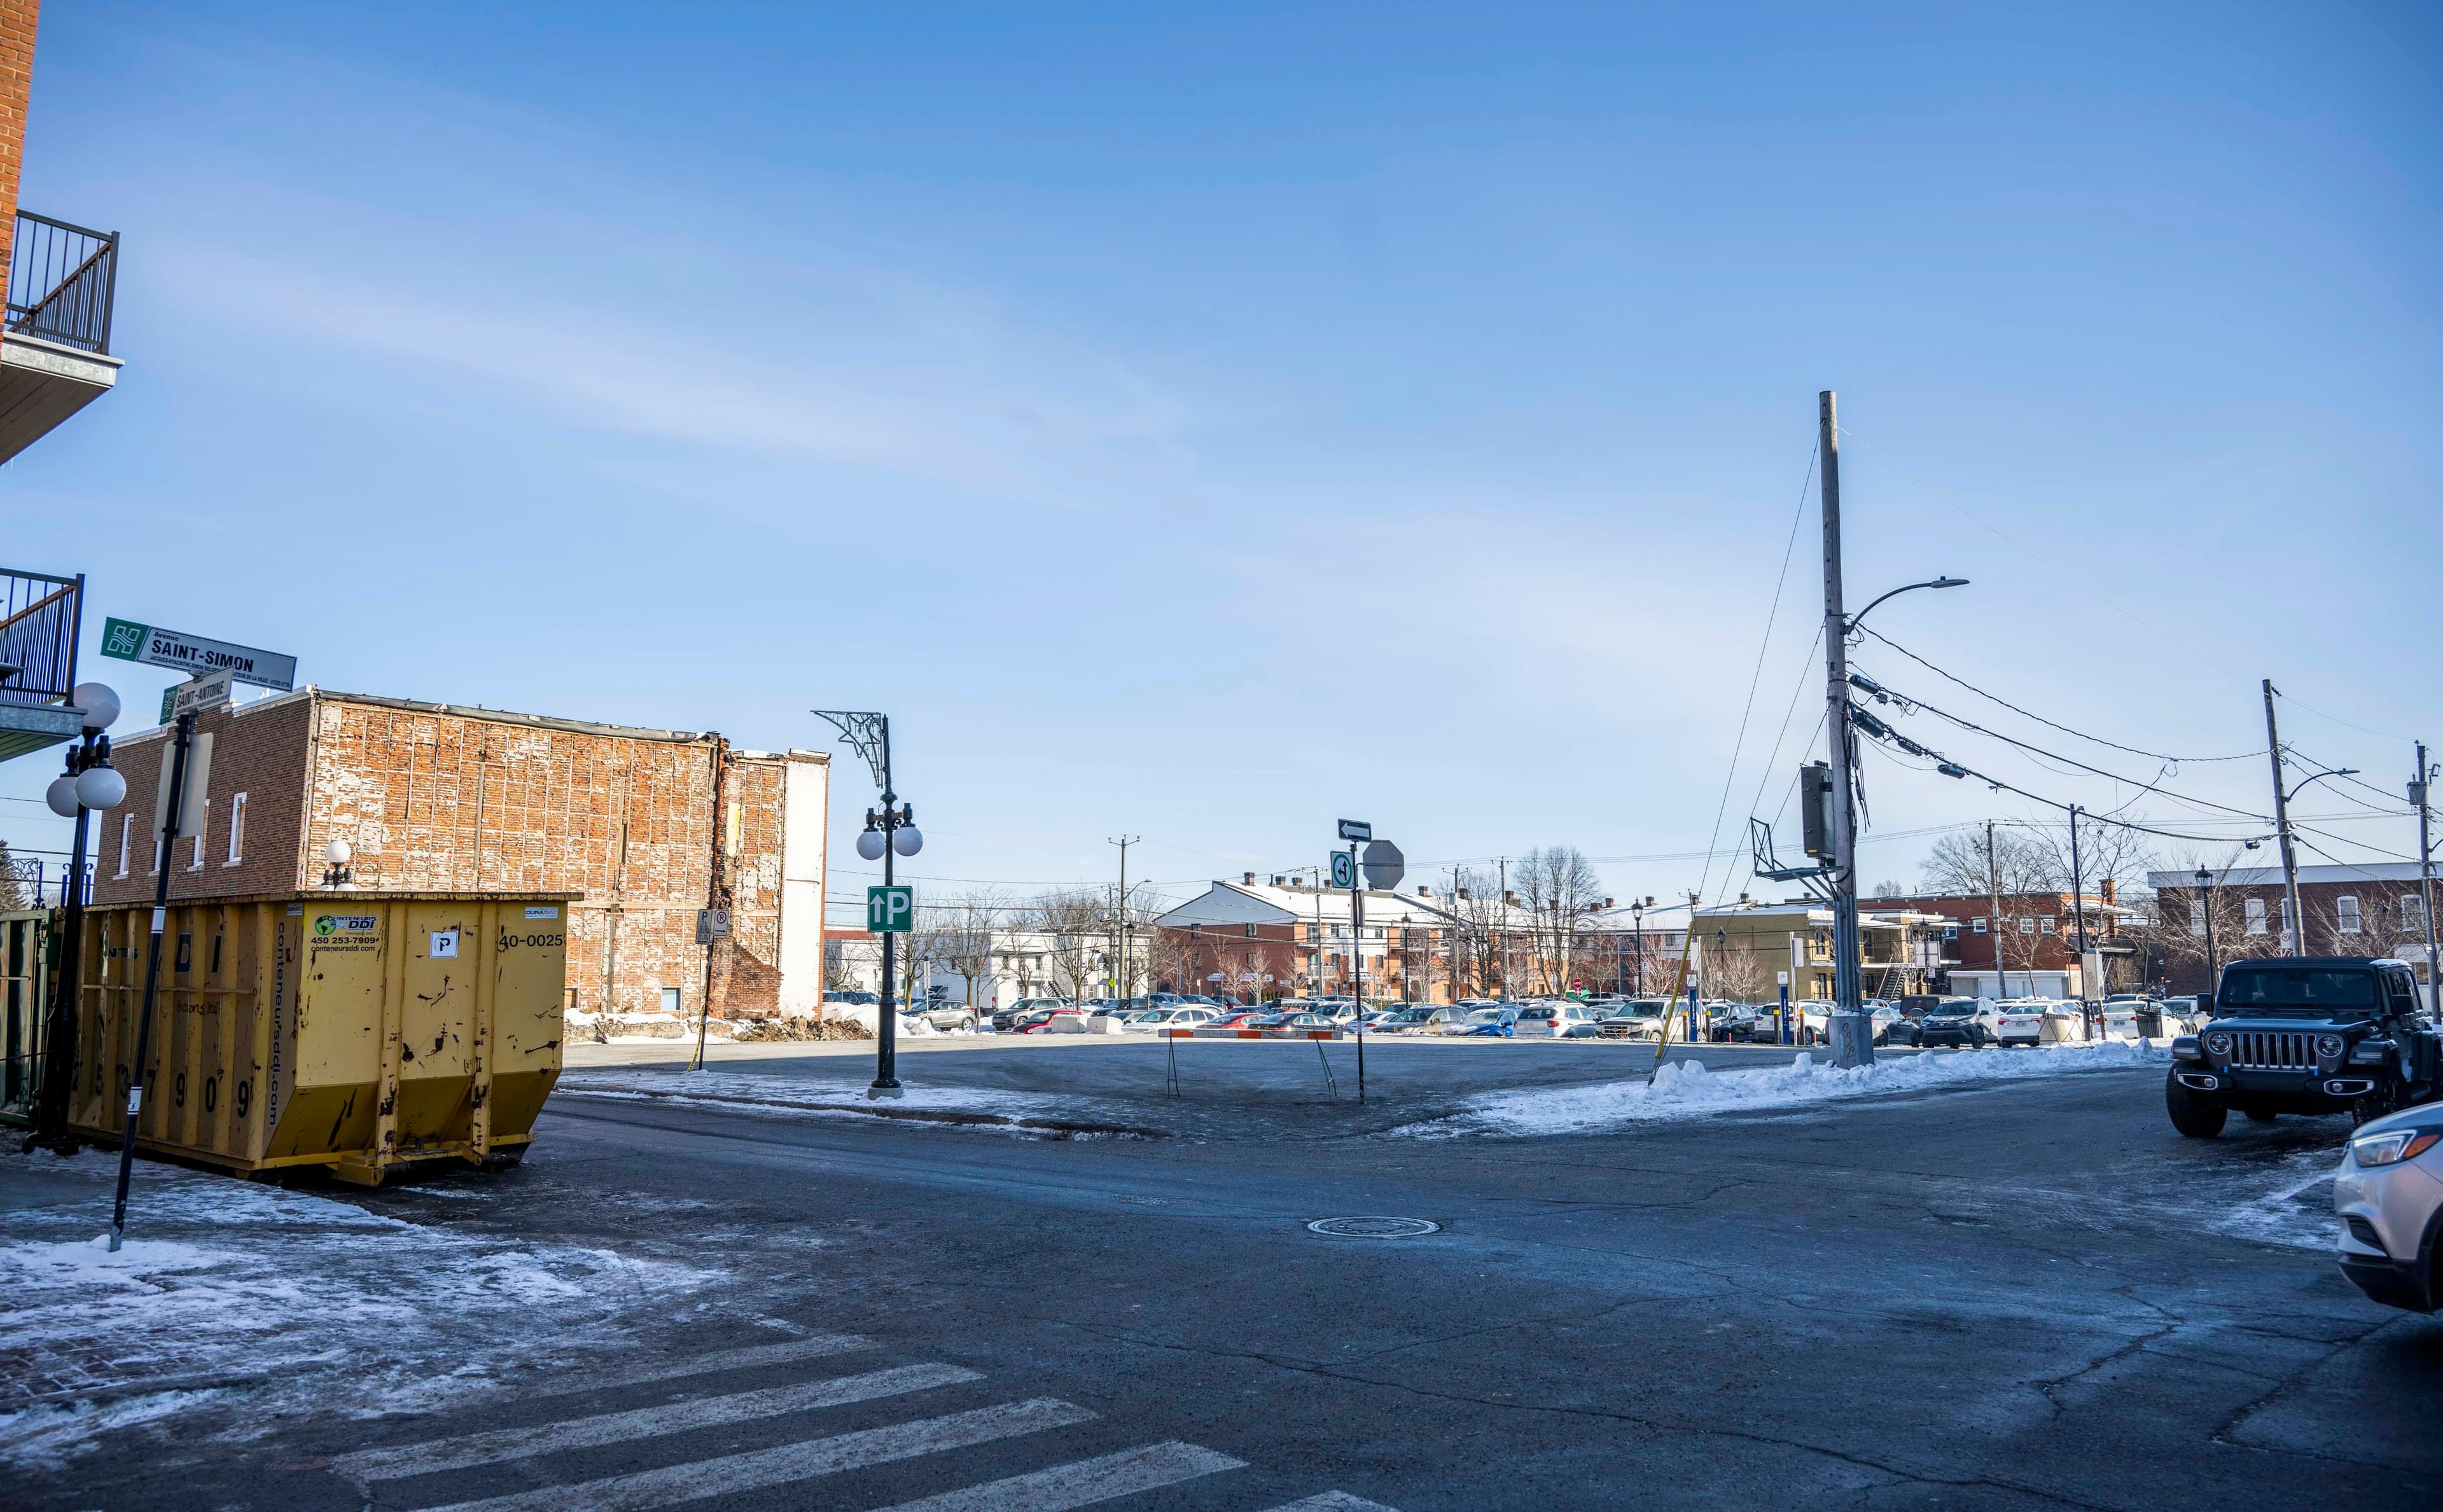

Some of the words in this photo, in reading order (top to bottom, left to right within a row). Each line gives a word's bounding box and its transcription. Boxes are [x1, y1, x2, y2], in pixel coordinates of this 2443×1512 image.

[154, 632, 179, 642] Avenue
[151, 639, 254, 672] SAINT-SIMON
[176, 680, 225, 708] SAINT-ANTOINE
[702, 912, 707, 920] P
[887, 892, 910, 925] P
[440, 937, 450, 952] P
[269, 922, 285, 1126] conteneursddi.com
